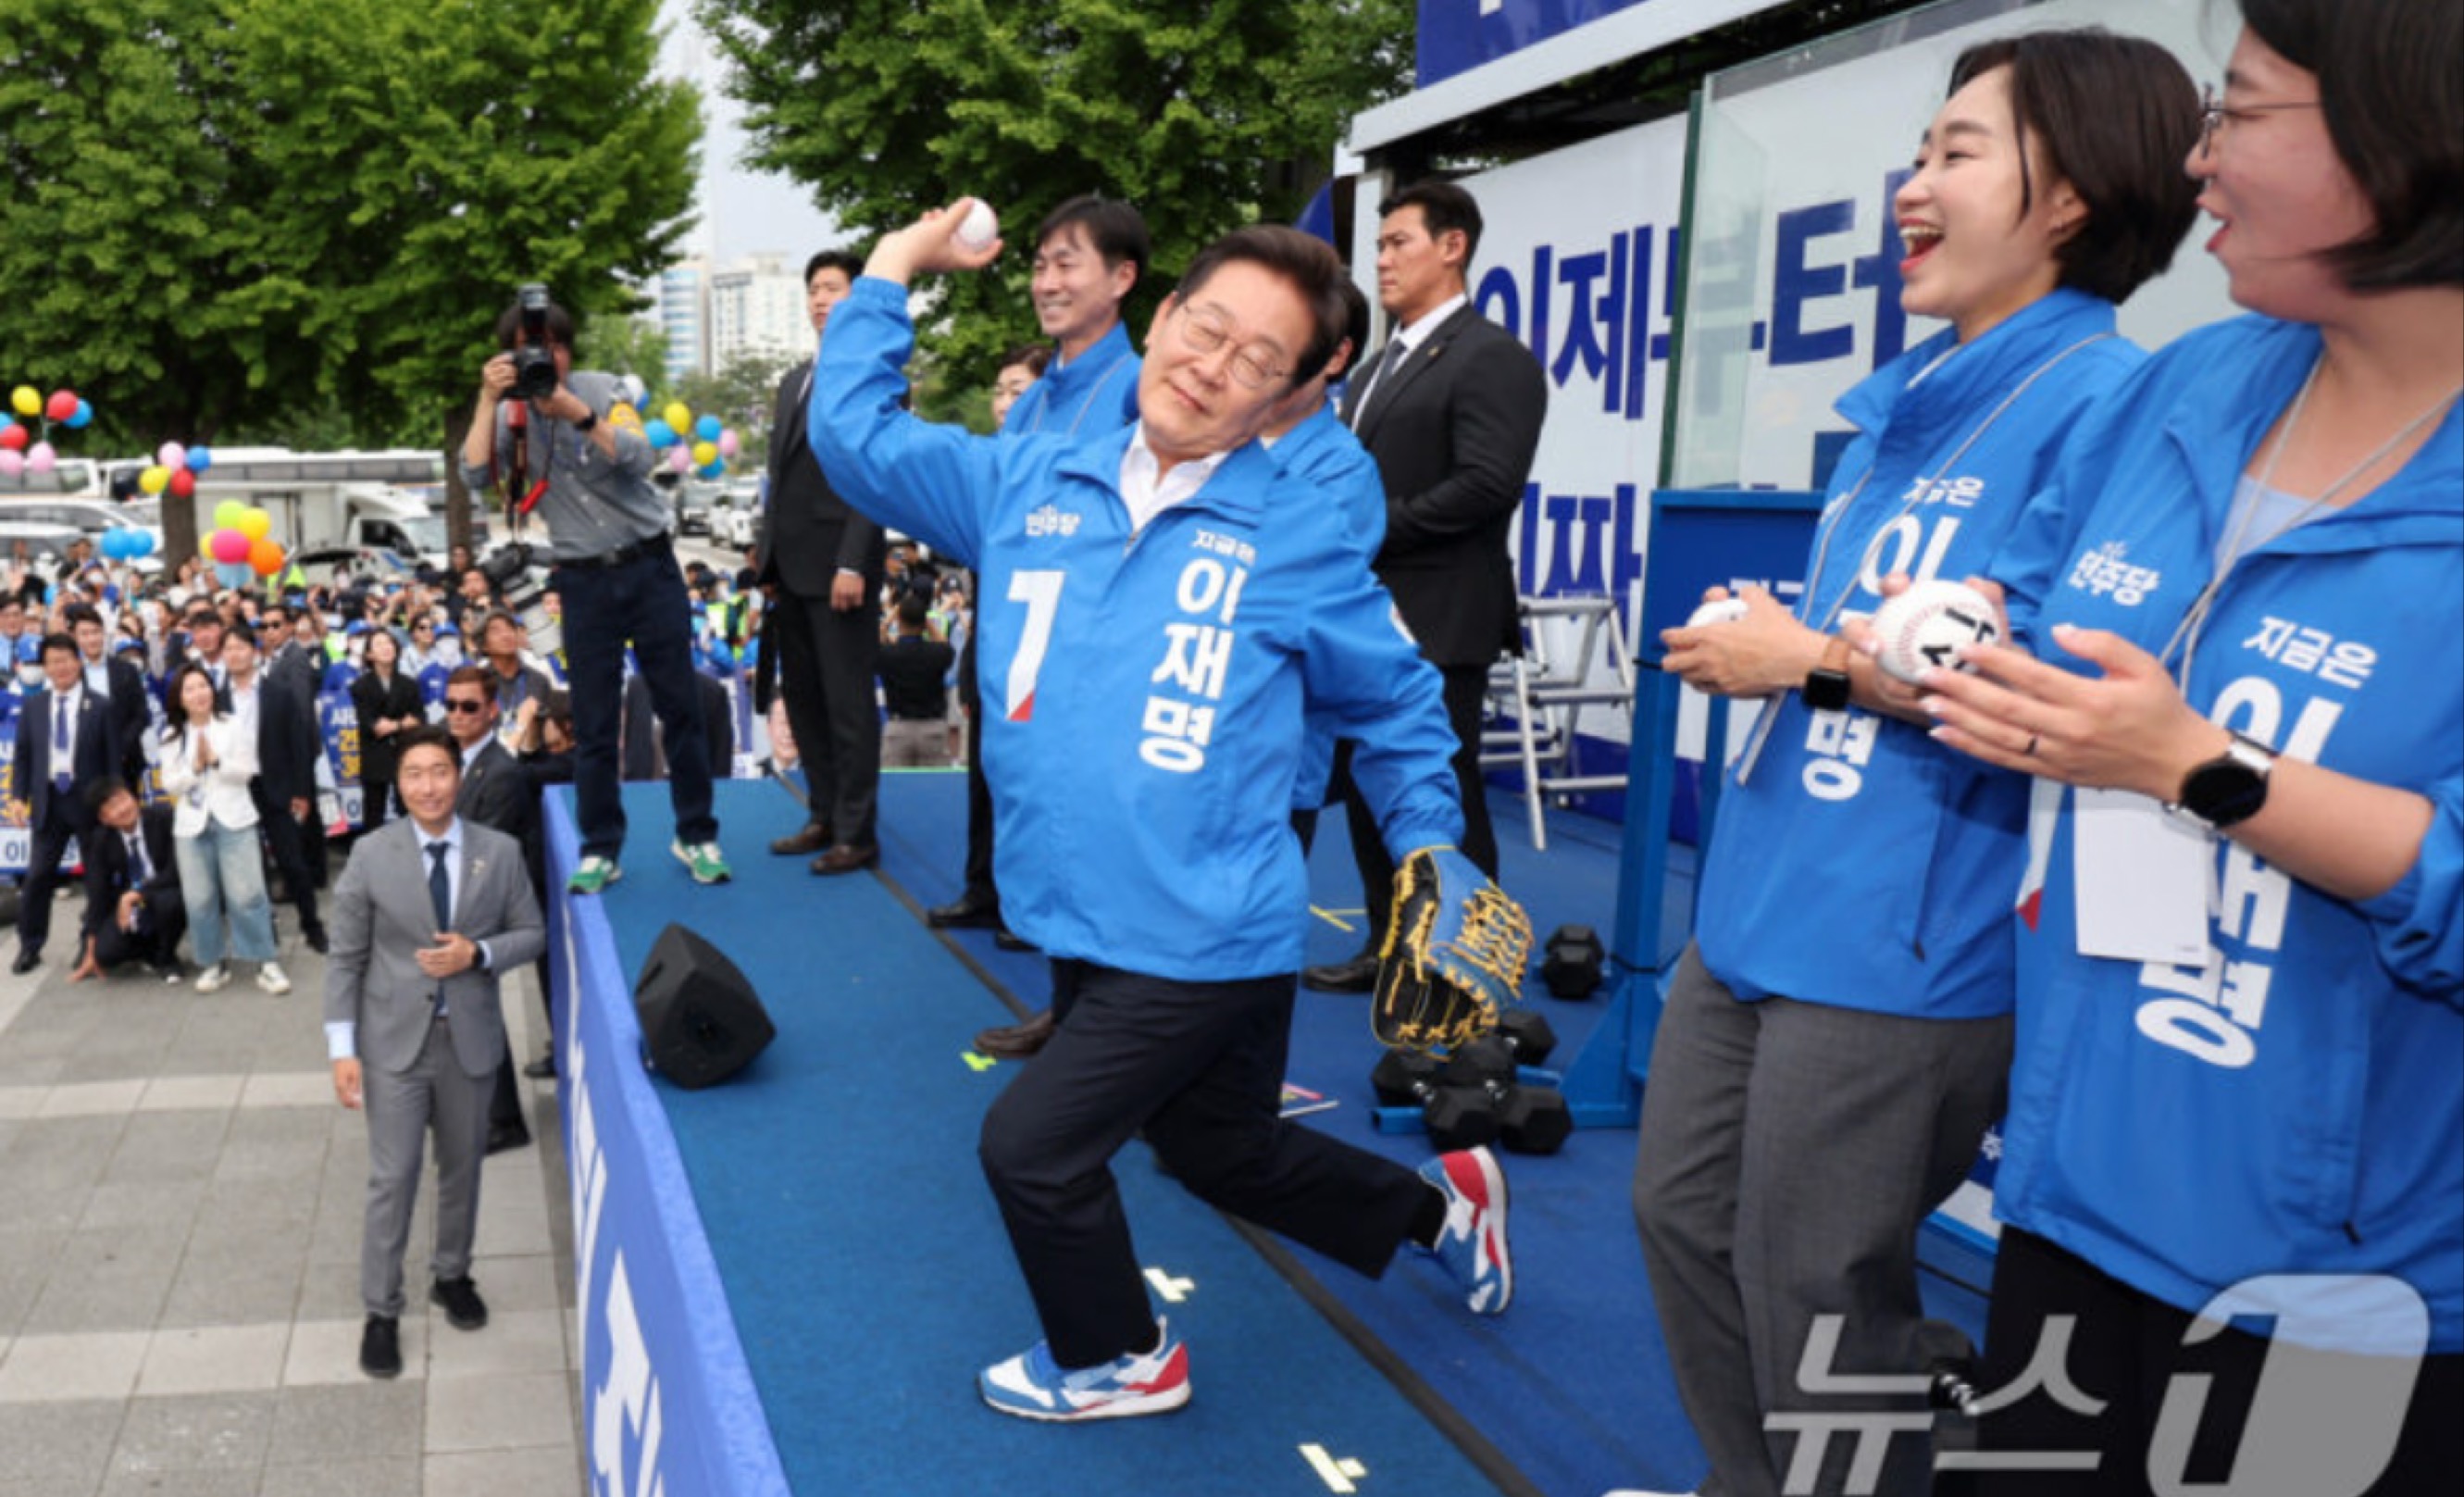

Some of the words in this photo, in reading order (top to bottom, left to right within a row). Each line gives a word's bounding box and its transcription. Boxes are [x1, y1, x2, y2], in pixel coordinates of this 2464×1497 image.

[2068, 551, 2160, 607] 민주당
[1139, 557, 1248, 774] 이재명
[2242, 616, 2380, 690] 지금은
